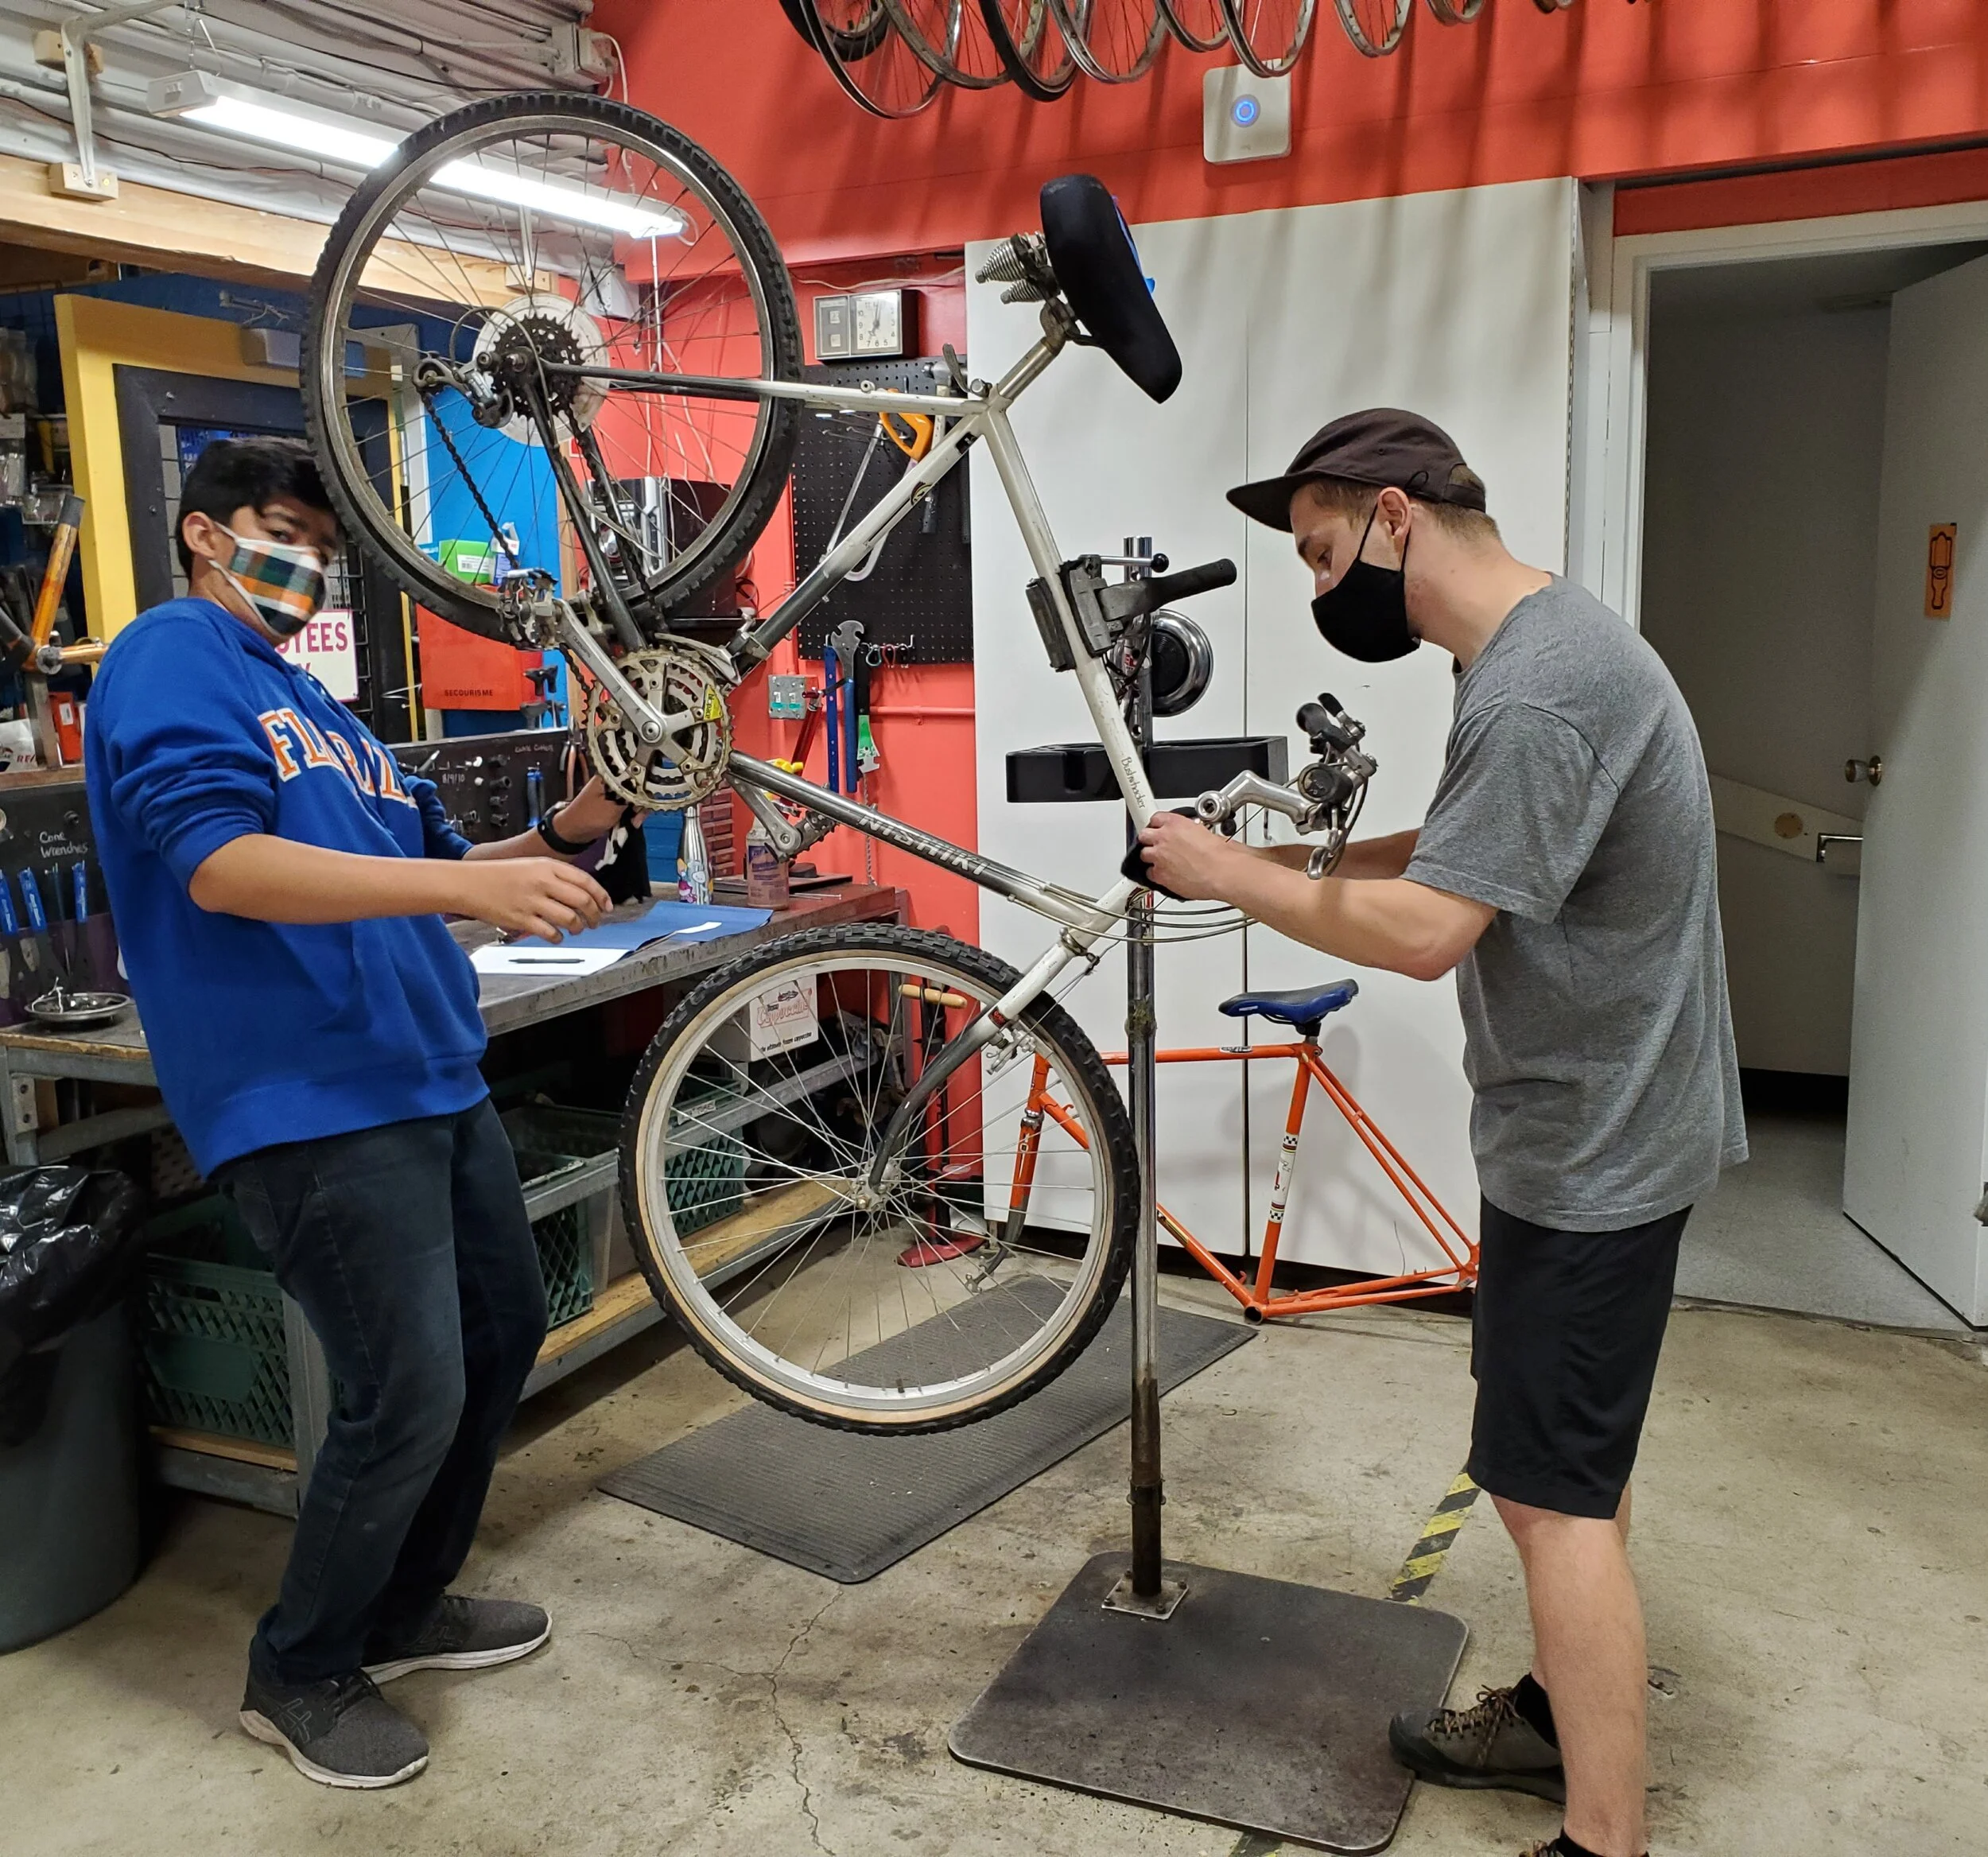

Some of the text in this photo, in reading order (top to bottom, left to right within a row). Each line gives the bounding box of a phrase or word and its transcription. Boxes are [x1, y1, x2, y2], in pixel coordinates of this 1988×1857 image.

[40, 831, 67, 844] Cone
[858, 815, 989, 876] NISHIKI
[40, 841, 88, 858] Wrenches
